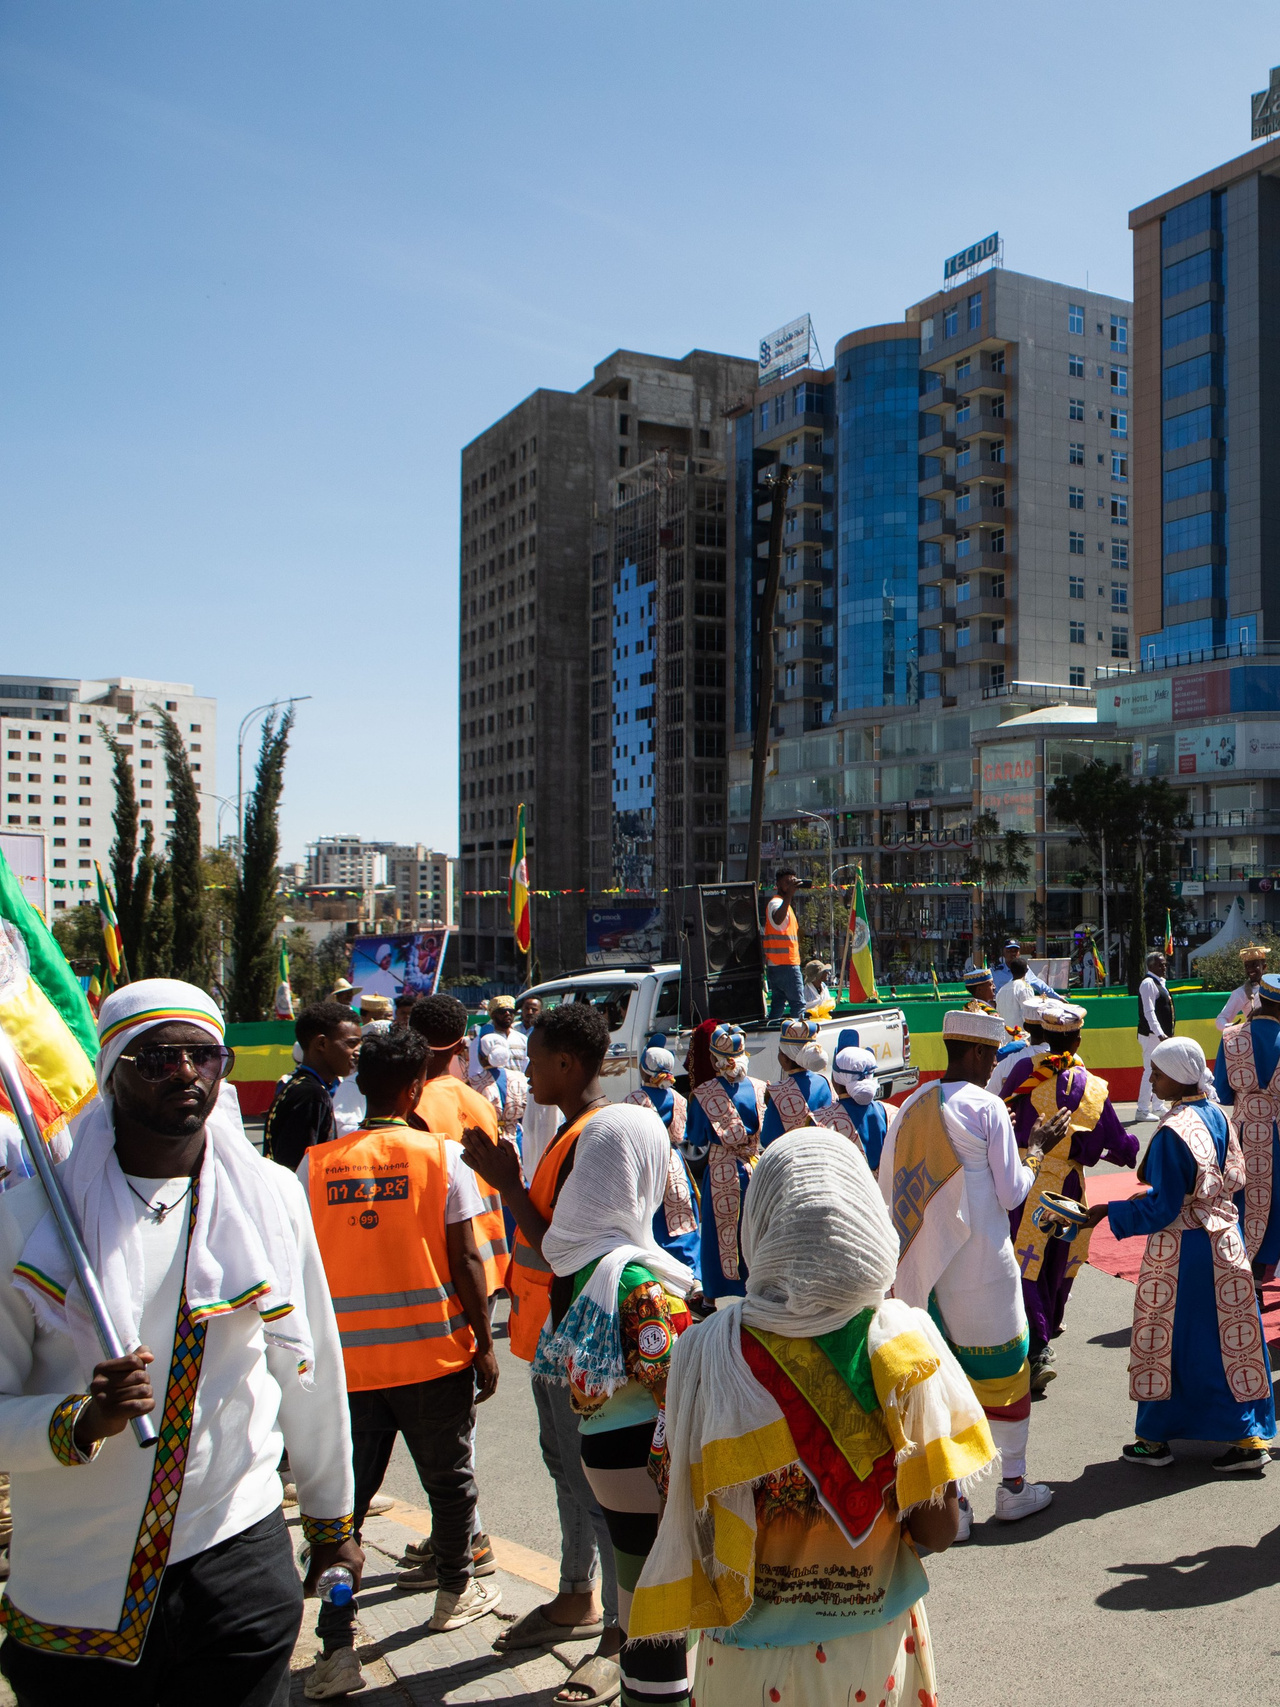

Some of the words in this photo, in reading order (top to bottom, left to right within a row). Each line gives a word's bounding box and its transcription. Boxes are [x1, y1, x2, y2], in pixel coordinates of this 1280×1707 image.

[1252, 121, 1280, 138] Bank
[946, 235, 996, 276] TECNO
[1121, 696, 1131, 705] IVY
[1132, 695, 1149, 703] HOTEL
[984, 759, 1034, 782] GARAD
[984, 794, 1001, 808] City
[1003, 792, 1033, 805] Center
[354, 1178, 407, 1200] ፈቃደኛ
[360, 1215, 378, 1225] 991
